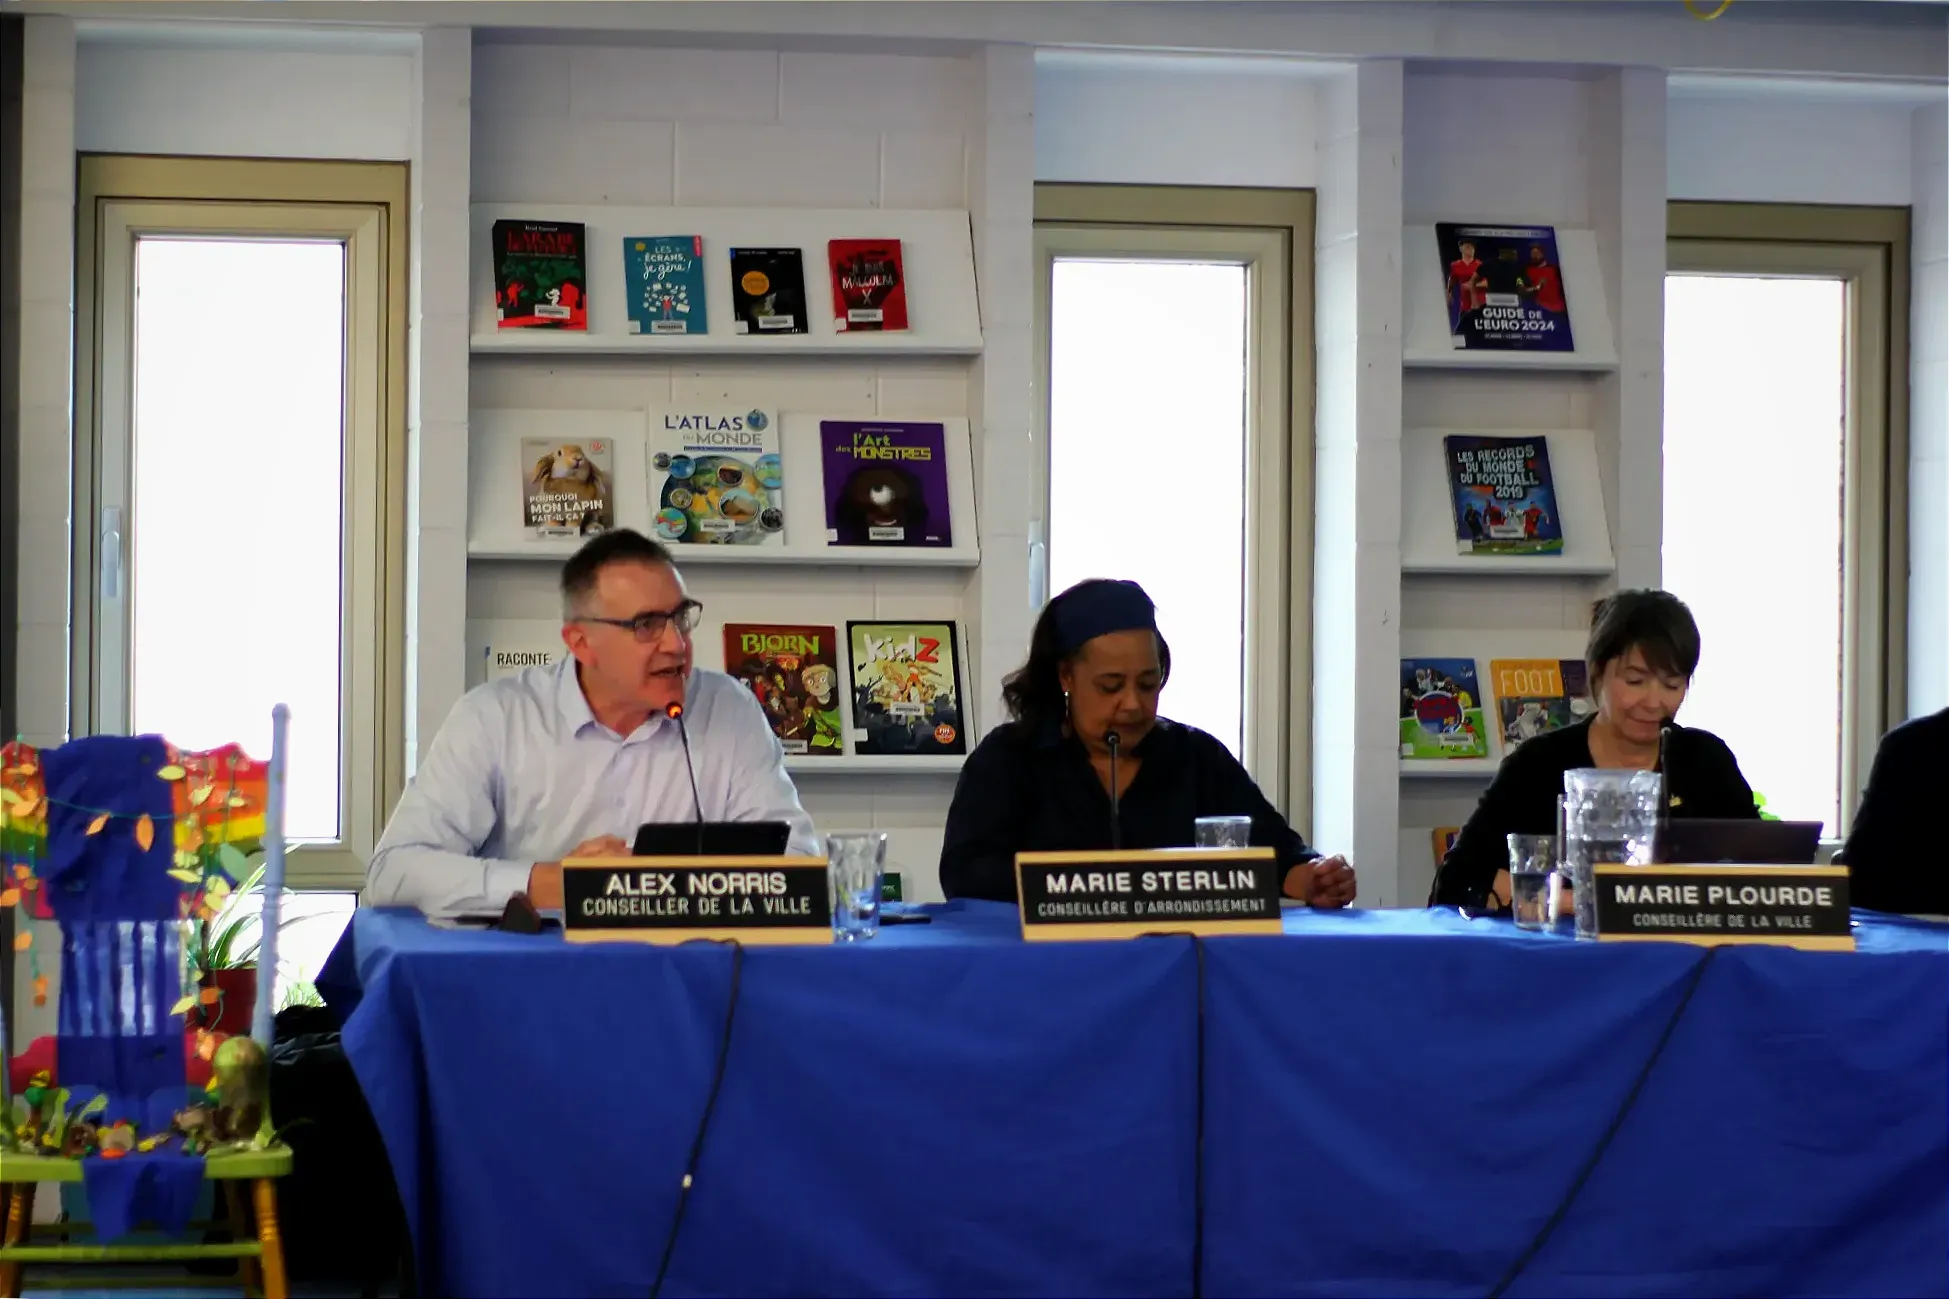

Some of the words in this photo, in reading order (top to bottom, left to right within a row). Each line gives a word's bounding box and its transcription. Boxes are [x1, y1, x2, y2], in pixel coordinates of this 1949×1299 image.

[655, 246, 671, 254] LES
[862, 288, 872, 305] X
[1482, 308, 1525, 319] GUIDE
[1528, 310, 1542, 320] DE
[1474, 319, 1519, 330] L'EURO
[1521, 320, 1555, 331] 2024
[665, 414, 743, 431] L'ATLAS
[696, 432, 762, 446] MONDE
[853, 446, 932, 461] MONSTRES
[1457, 452, 1475, 463] LES
[1477, 444, 1535, 461] RECORDS
[1466, 463, 1479, 473] DU
[1482, 460, 1526, 473] MONDE
[1460, 473, 1473, 484] DU
[1476, 472, 1540, 486] FOOTBALL
[529, 493, 578, 504] POURQUOI
[530, 503, 562, 514] MON
[564, 500, 604, 512] LAPIN
[1500, 668, 1556, 696] FOOT
[606, 873, 676, 896] ALEX
[688, 872, 787, 895] NORRIS
[1045, 872, 1132, 894] MARIE
[1141, 869, 1256, 892] STERLIN
[1615, 884, 1699, 905] MARIE
[1707, 886, 1833, 907] PLOURDE
[583, 898, 689, 917] CONSEILLER
[699, 897, 721, 915] DE
[730, 897, 755, 915] LA
[764, 896, 811, 915] VILLE
[1134, 898, 1266, 915] D'ARRONDISSEMENT
[1727, 913, 1746, 928] DE
[1751, 914, 1770, 928] LA
[1775, 914, 1813, 929] VILLE
